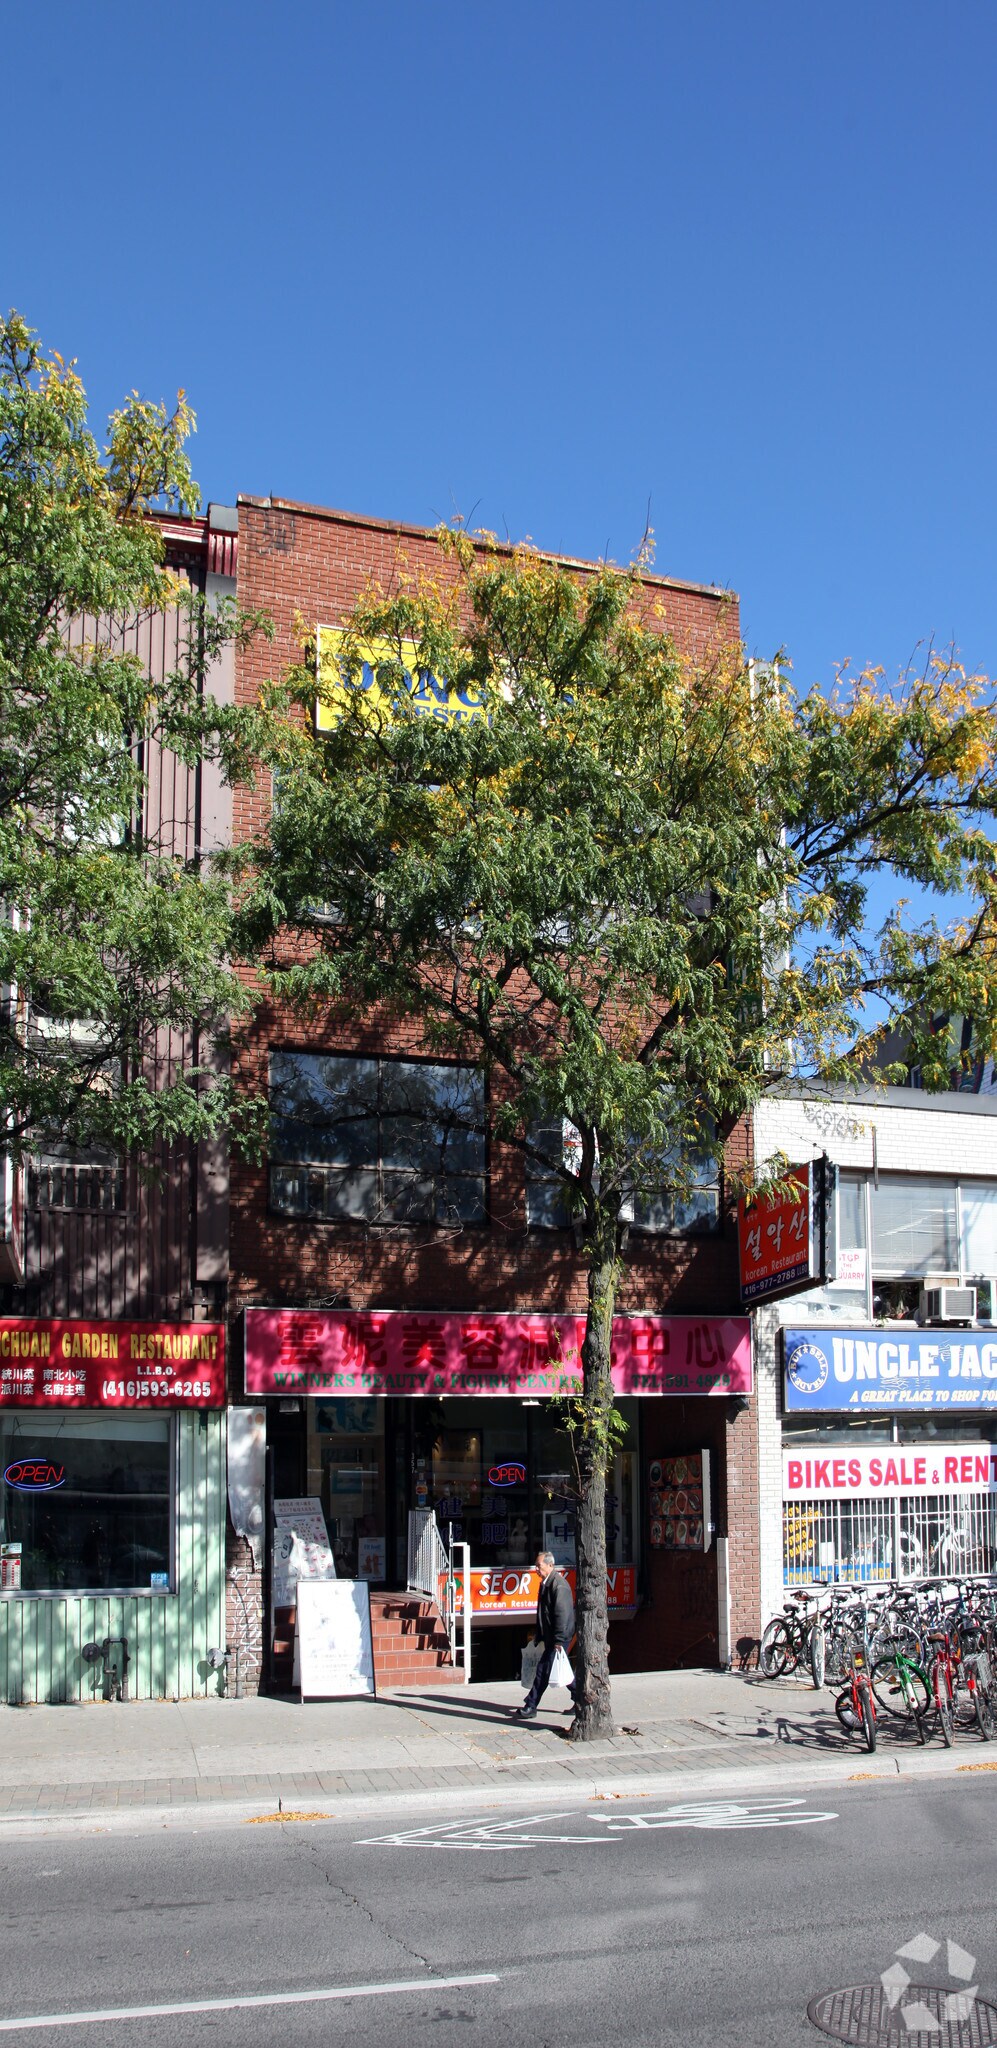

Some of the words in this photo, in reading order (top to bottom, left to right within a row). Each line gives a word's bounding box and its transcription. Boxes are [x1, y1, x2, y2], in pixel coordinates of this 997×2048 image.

[771, 1249, 807, 1271] Restaurant
[0, 1331, 50, 1357] CHUAN
[62, 1332, 118, 1359] GARDEN
[130, 1333, 218, 1360] RESTAURANT
[277, 1315, 726, 1370] 雲妮美容減中心
[791, 1349, 803, 1370] BUY
[809, 1347, 826, 1370] SELL
[832, 1337, 940, 1383] UNCLE
[43, 1368, 87, 1381] 南北小吃
[137, 1366, 176, 1376] L.L.B.O.
[43, 1383, 86, 1396] 名廚主理
[103, 1380, 211, 1399] (416)593-6265
[274, 1373, 356, 1388] WINNERS
[361, 1373, 429, 1389] BEAUTY
[433, 1374, 445, 1388] &
[451, 1374, 512, 1389] FIGURE
[795, 1377, 824, 1391] TRADE
[849, 1390, 859, 1403] A
[861, 1390, 898, 1403] GREAT
[898, 1390, 934, 1403] PLACE
[935, 1390, 950, 1403] TO
[951, 1389, 980, 1403] SHOP
[6, 1465, 65, 1482] OPEN
[488, 1466, 526, 1482] OPEN
[788, 1458, 863, 1489] BIKES
[868, 1457, 927, 1487] SALE
[931, 1469, 940, 1485] &
[478, 1572, 533, 1597] SEOR
[480, 1600, 507, 1609] korean
[511, 1599, 538, 1608] Restau
